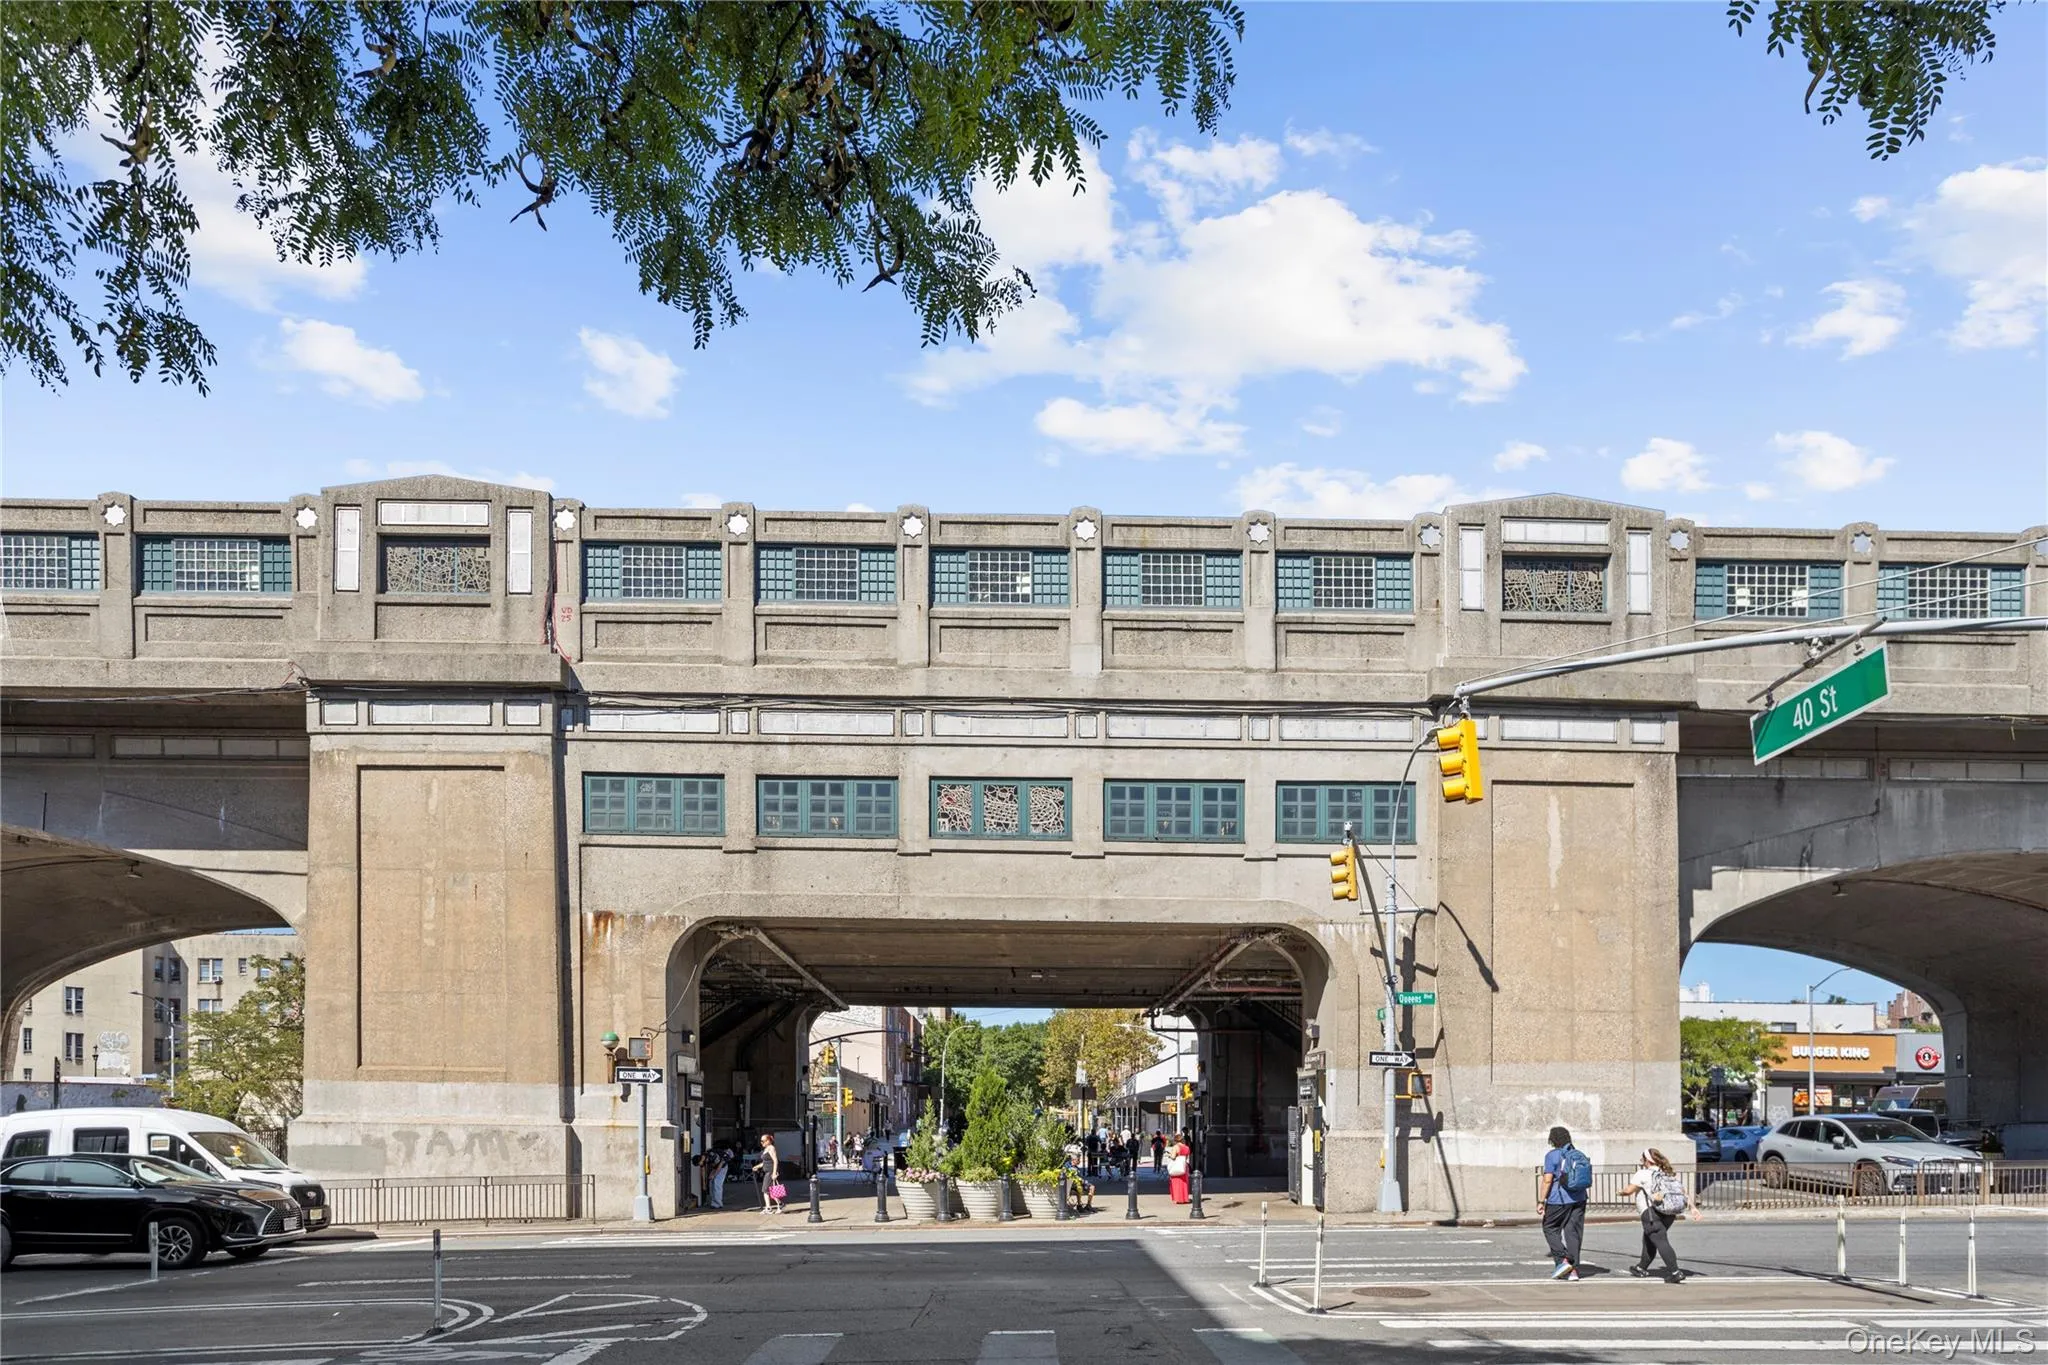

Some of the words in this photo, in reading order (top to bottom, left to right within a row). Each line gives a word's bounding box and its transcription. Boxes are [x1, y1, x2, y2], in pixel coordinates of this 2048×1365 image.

[1792, 698, 1813, 730] 40
[1820, 685, 1838, 718] St
[1399, 994, 1422, 1004] Queens
[1840, 1047, 1870, 1060] KING
